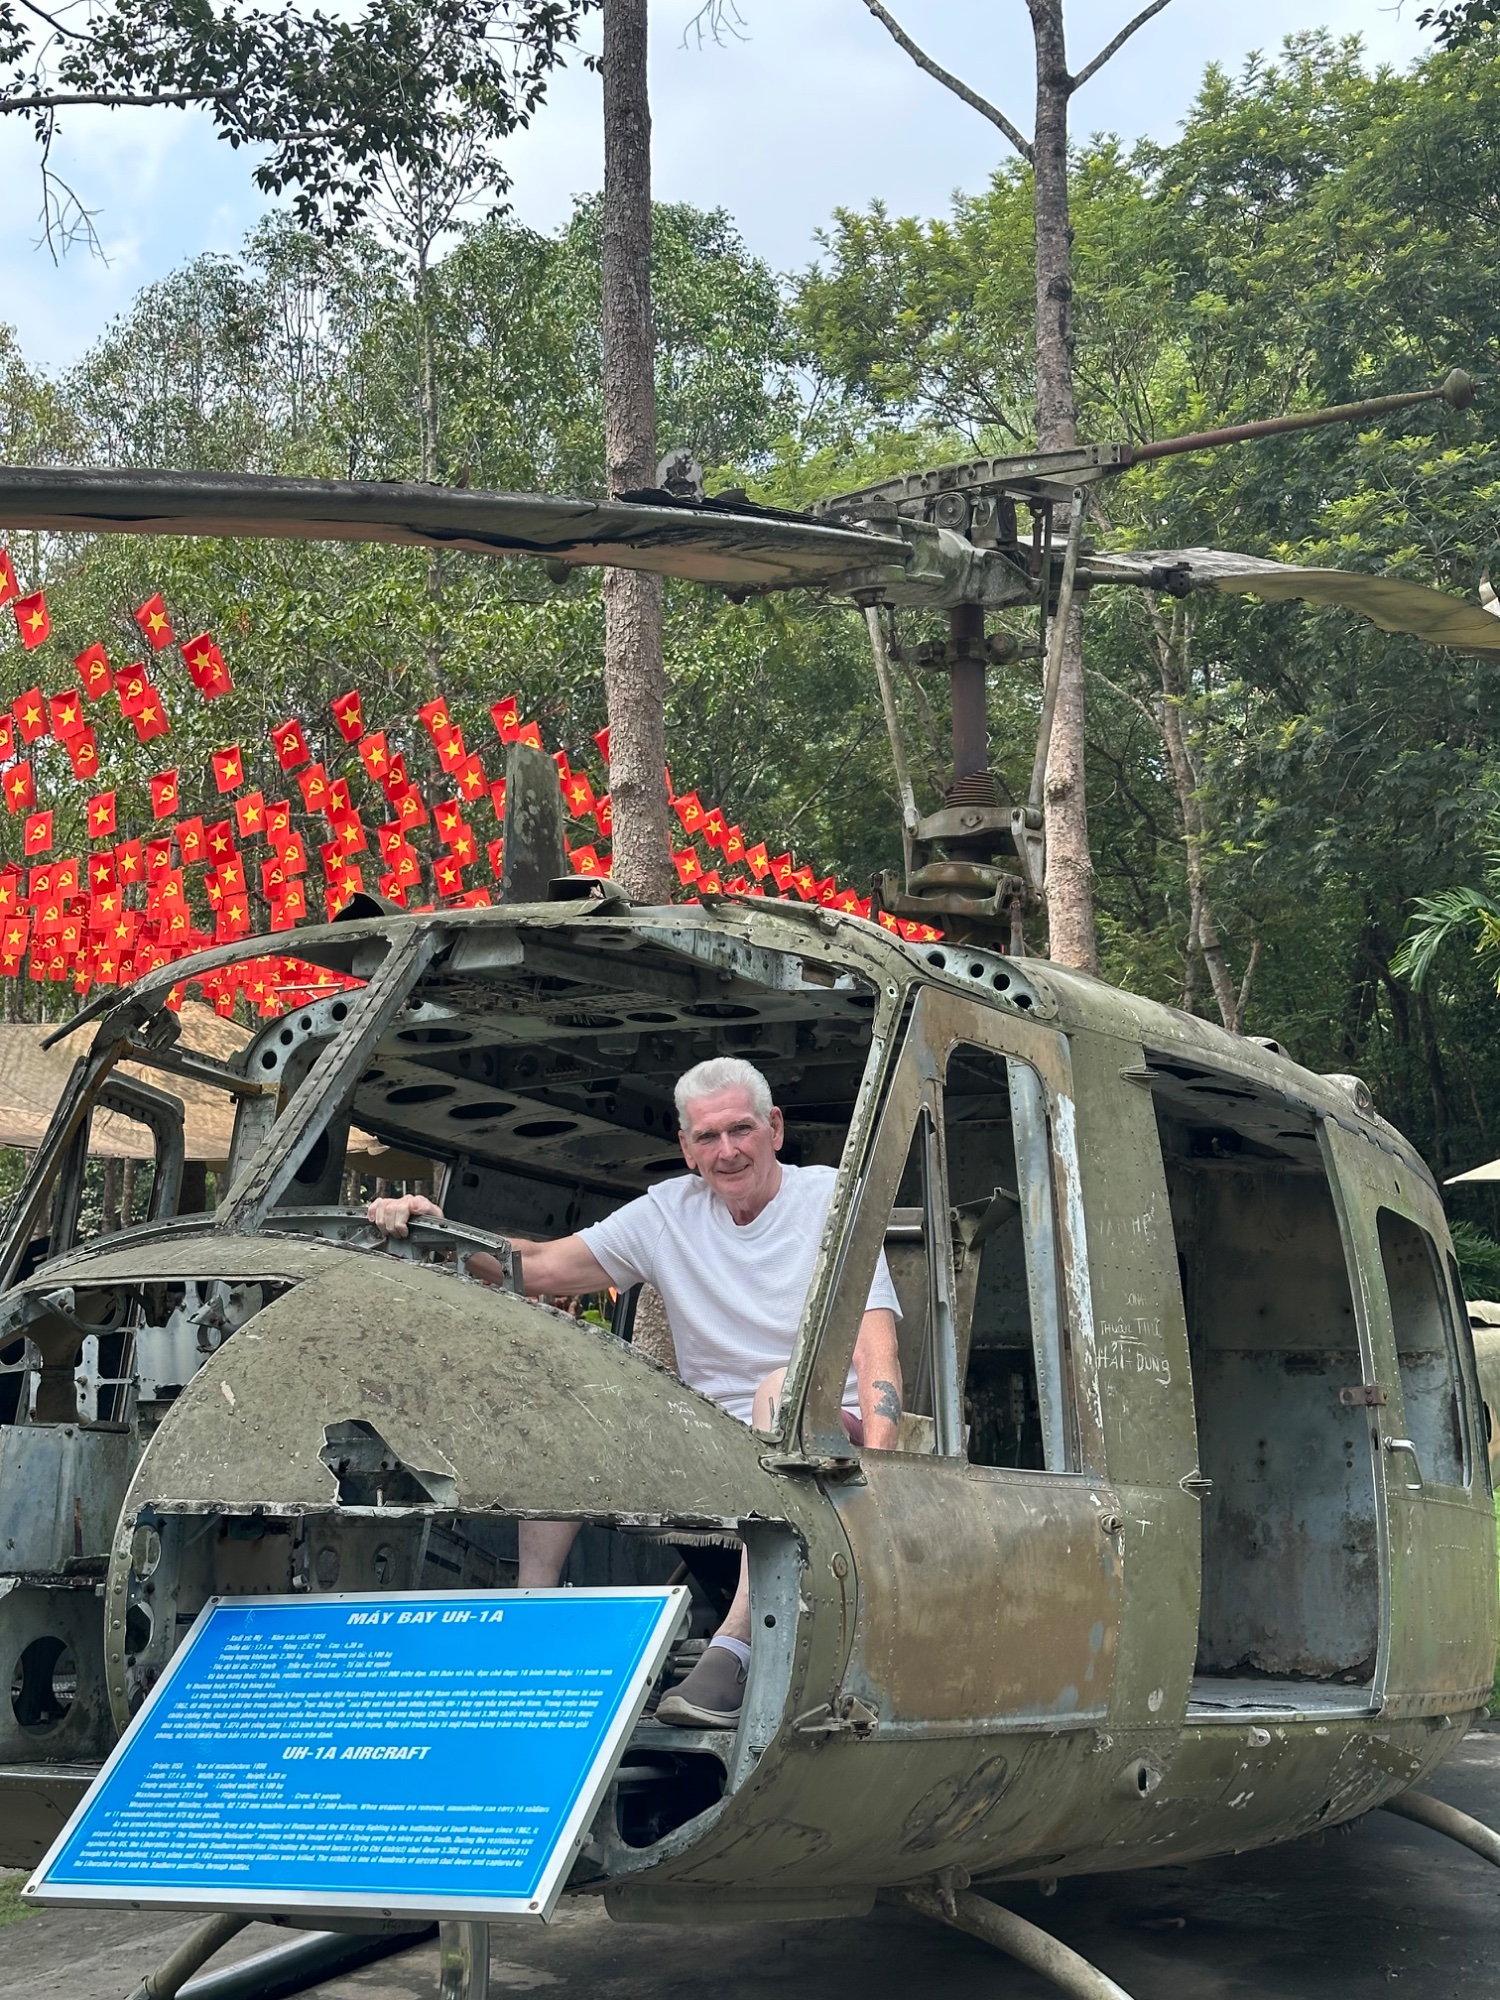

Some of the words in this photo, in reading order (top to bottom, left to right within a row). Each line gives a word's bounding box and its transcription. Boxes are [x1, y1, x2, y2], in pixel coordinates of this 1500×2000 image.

[347, 1610, 394, 1625] MÁY
[397, 1611, 438, 1624] BAY
[442, 1609, 503, 1623] UH-1A
[283, 1746, 337, 1760] UH-1A
[340, 1746, 431, 1760] AIRCRAFT
